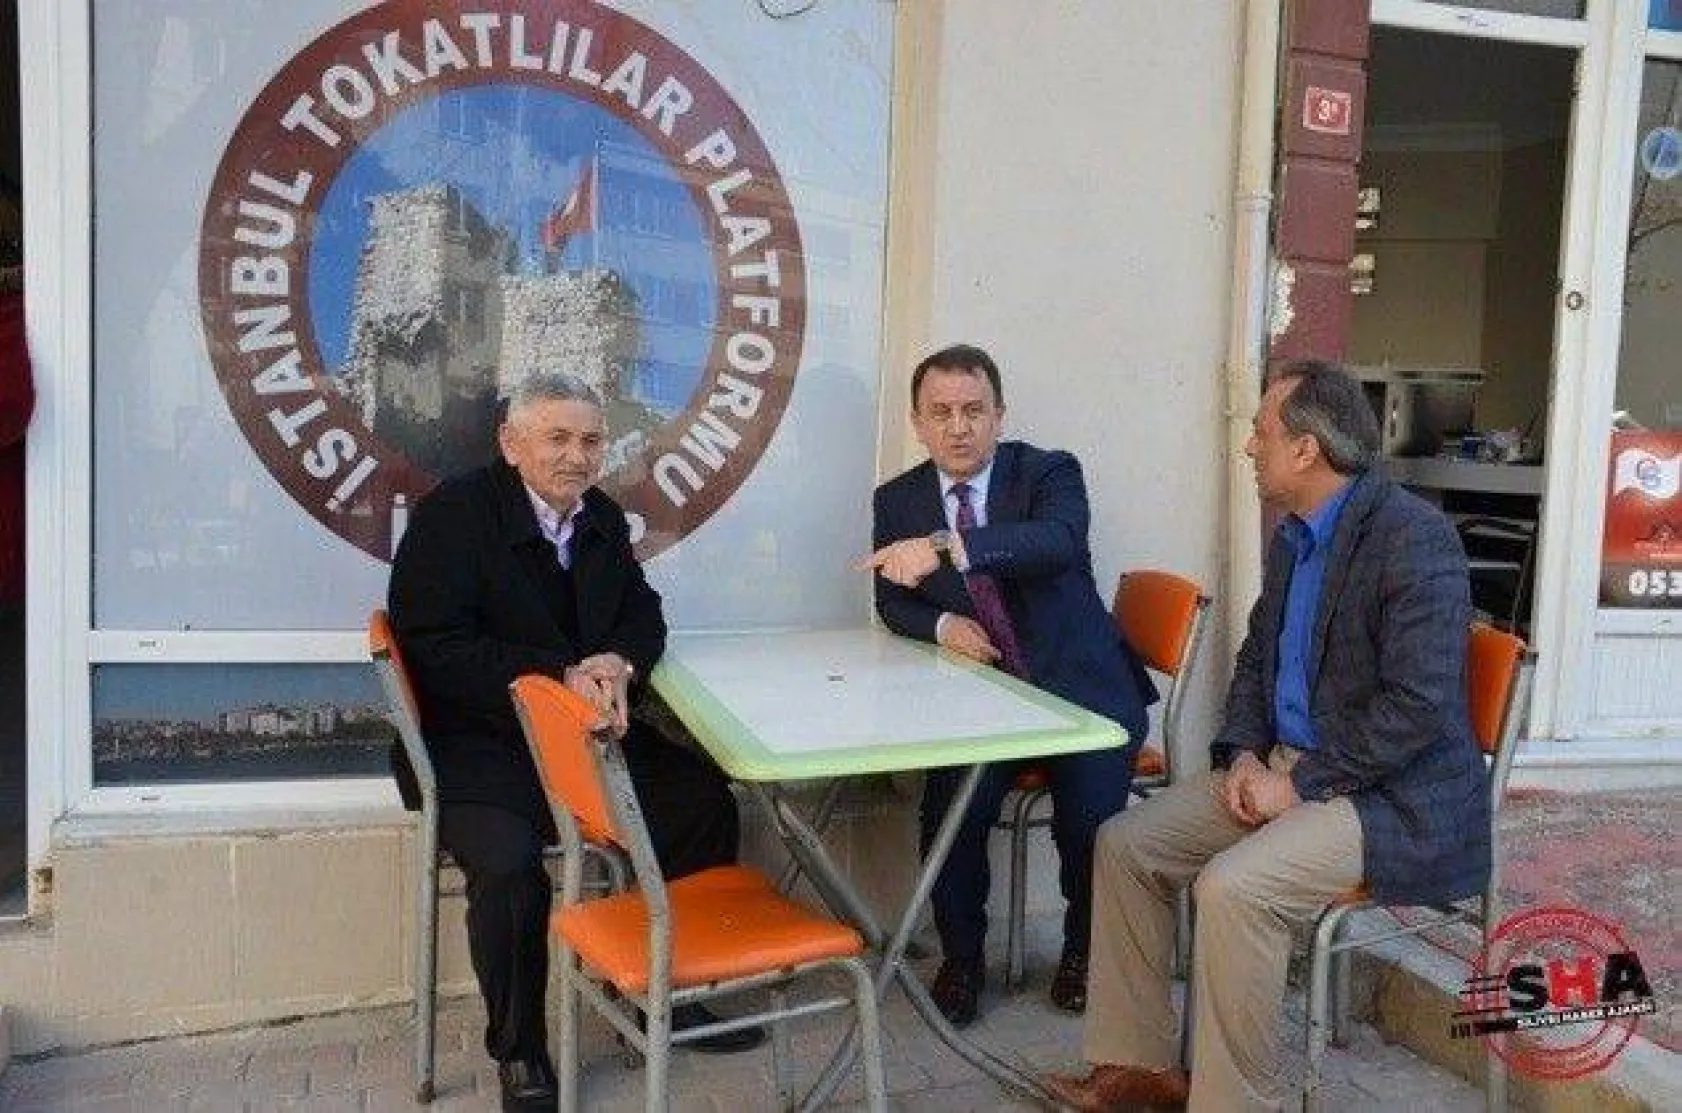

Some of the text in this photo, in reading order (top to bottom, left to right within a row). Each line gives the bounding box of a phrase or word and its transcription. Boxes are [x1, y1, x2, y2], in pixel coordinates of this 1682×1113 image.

[230, 12, 783, 512] İSTANBUL TOKATLILAR PLATFORMU
